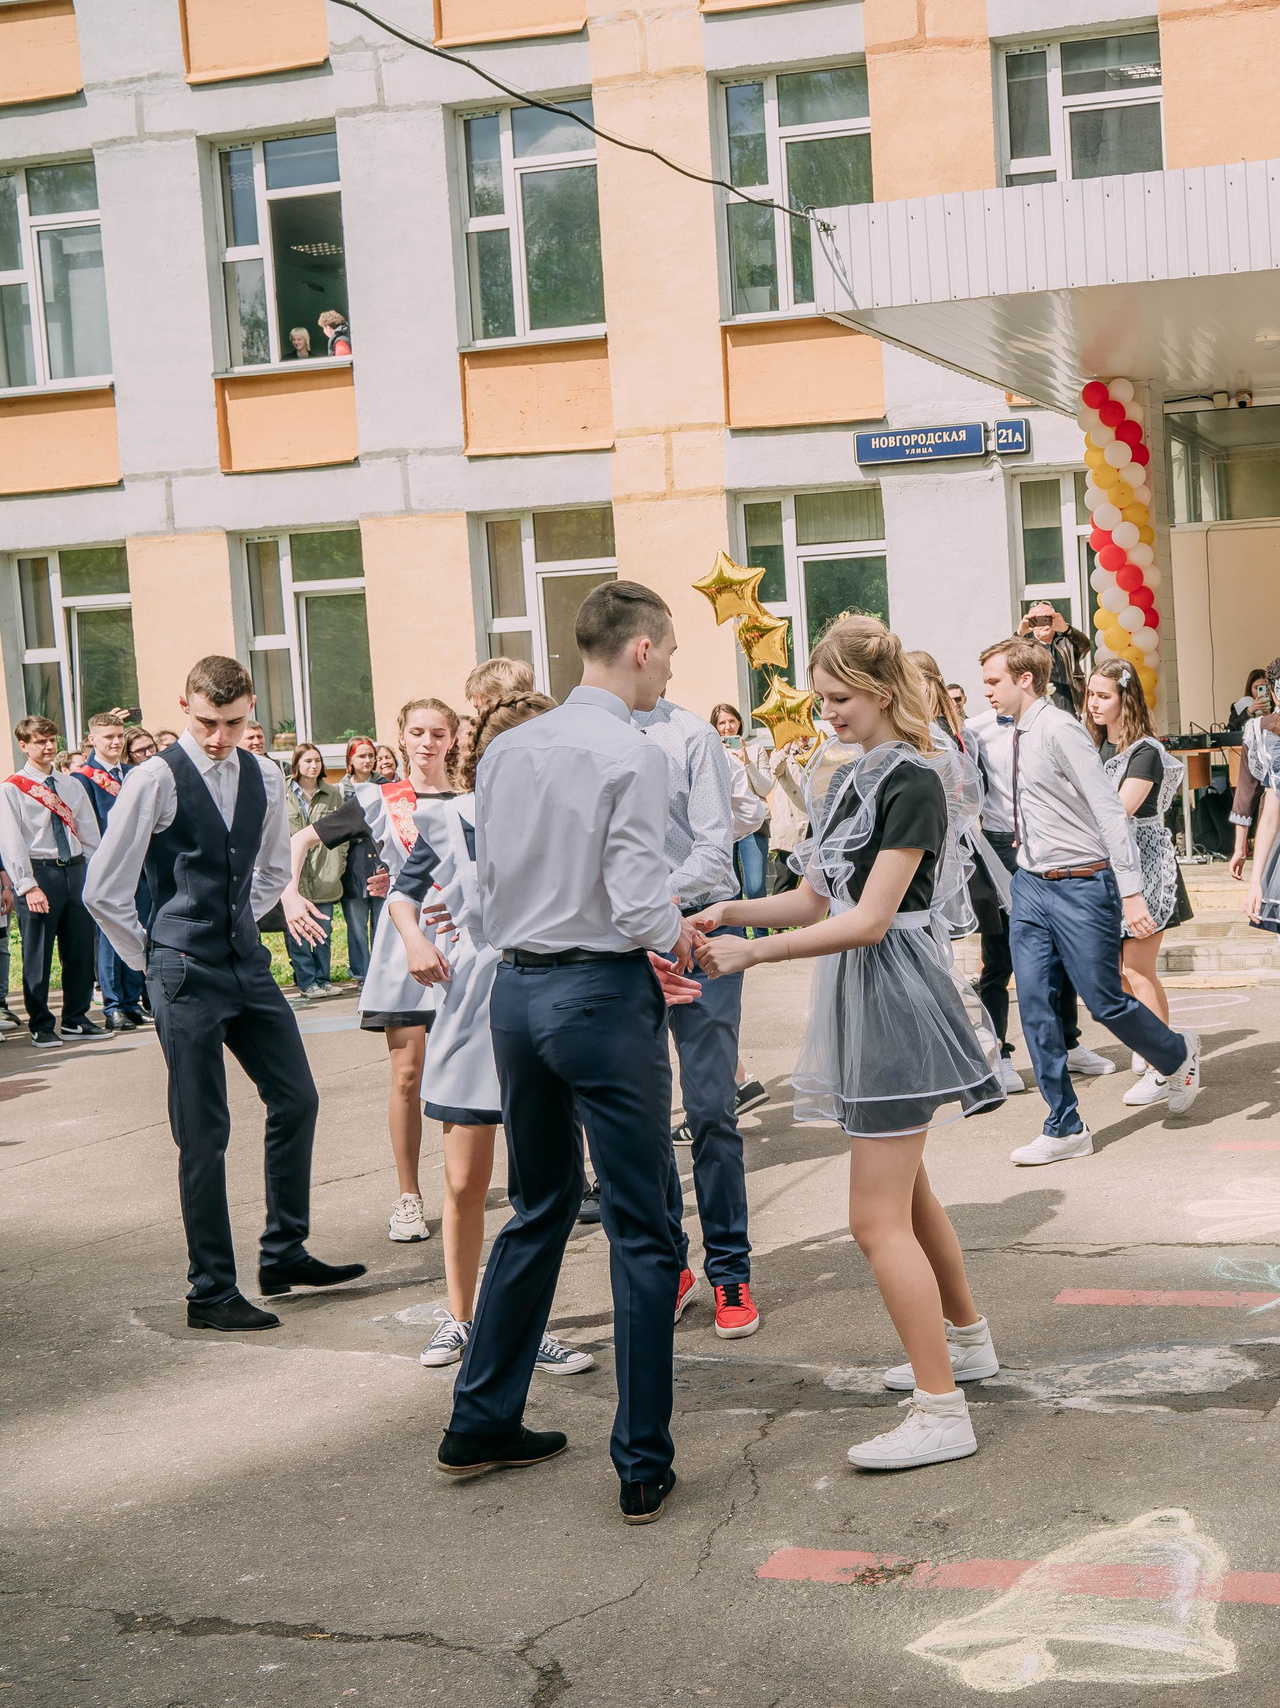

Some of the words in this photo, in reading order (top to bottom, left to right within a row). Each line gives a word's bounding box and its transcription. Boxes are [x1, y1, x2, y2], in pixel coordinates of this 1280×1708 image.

[871, 429, 967, 449] НОВГОРОДСКАЯ
[998, 428, 1023, 444] 21А
[905, 447, 933, 455] УЛИЦА
